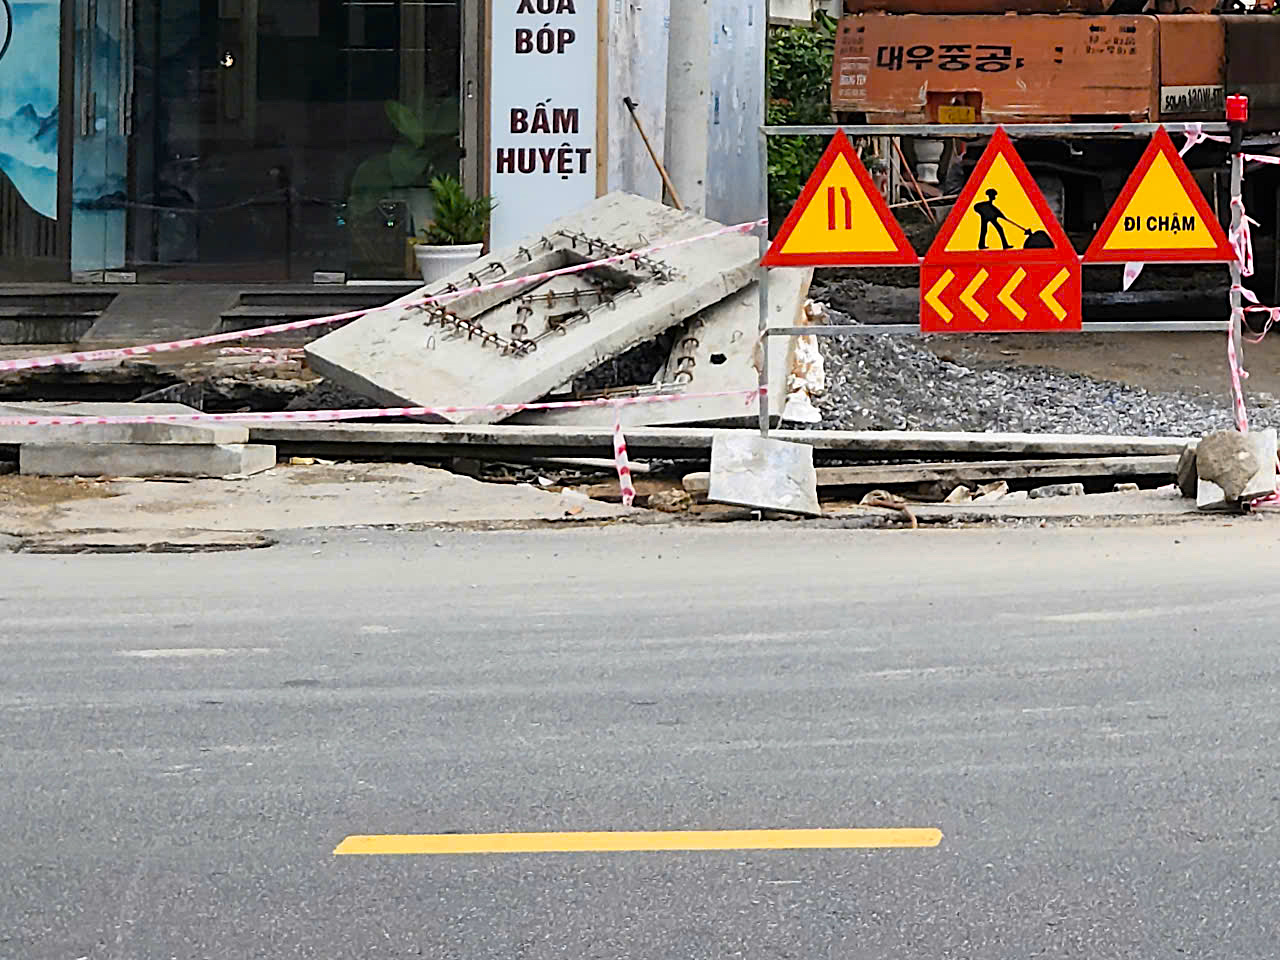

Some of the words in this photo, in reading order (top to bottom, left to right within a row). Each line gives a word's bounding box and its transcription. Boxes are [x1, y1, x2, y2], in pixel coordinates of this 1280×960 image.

[515, 23, 576, 54] BÓP
[876, 44, 1025, 73] 대우중공
[510, 98, 579, 134] BẤM
[496, 143, 591, 180] HUYỆT
[1124, 215, 1140, 231] ĐI
[1146, 212, 1195, 235] CHẬM
